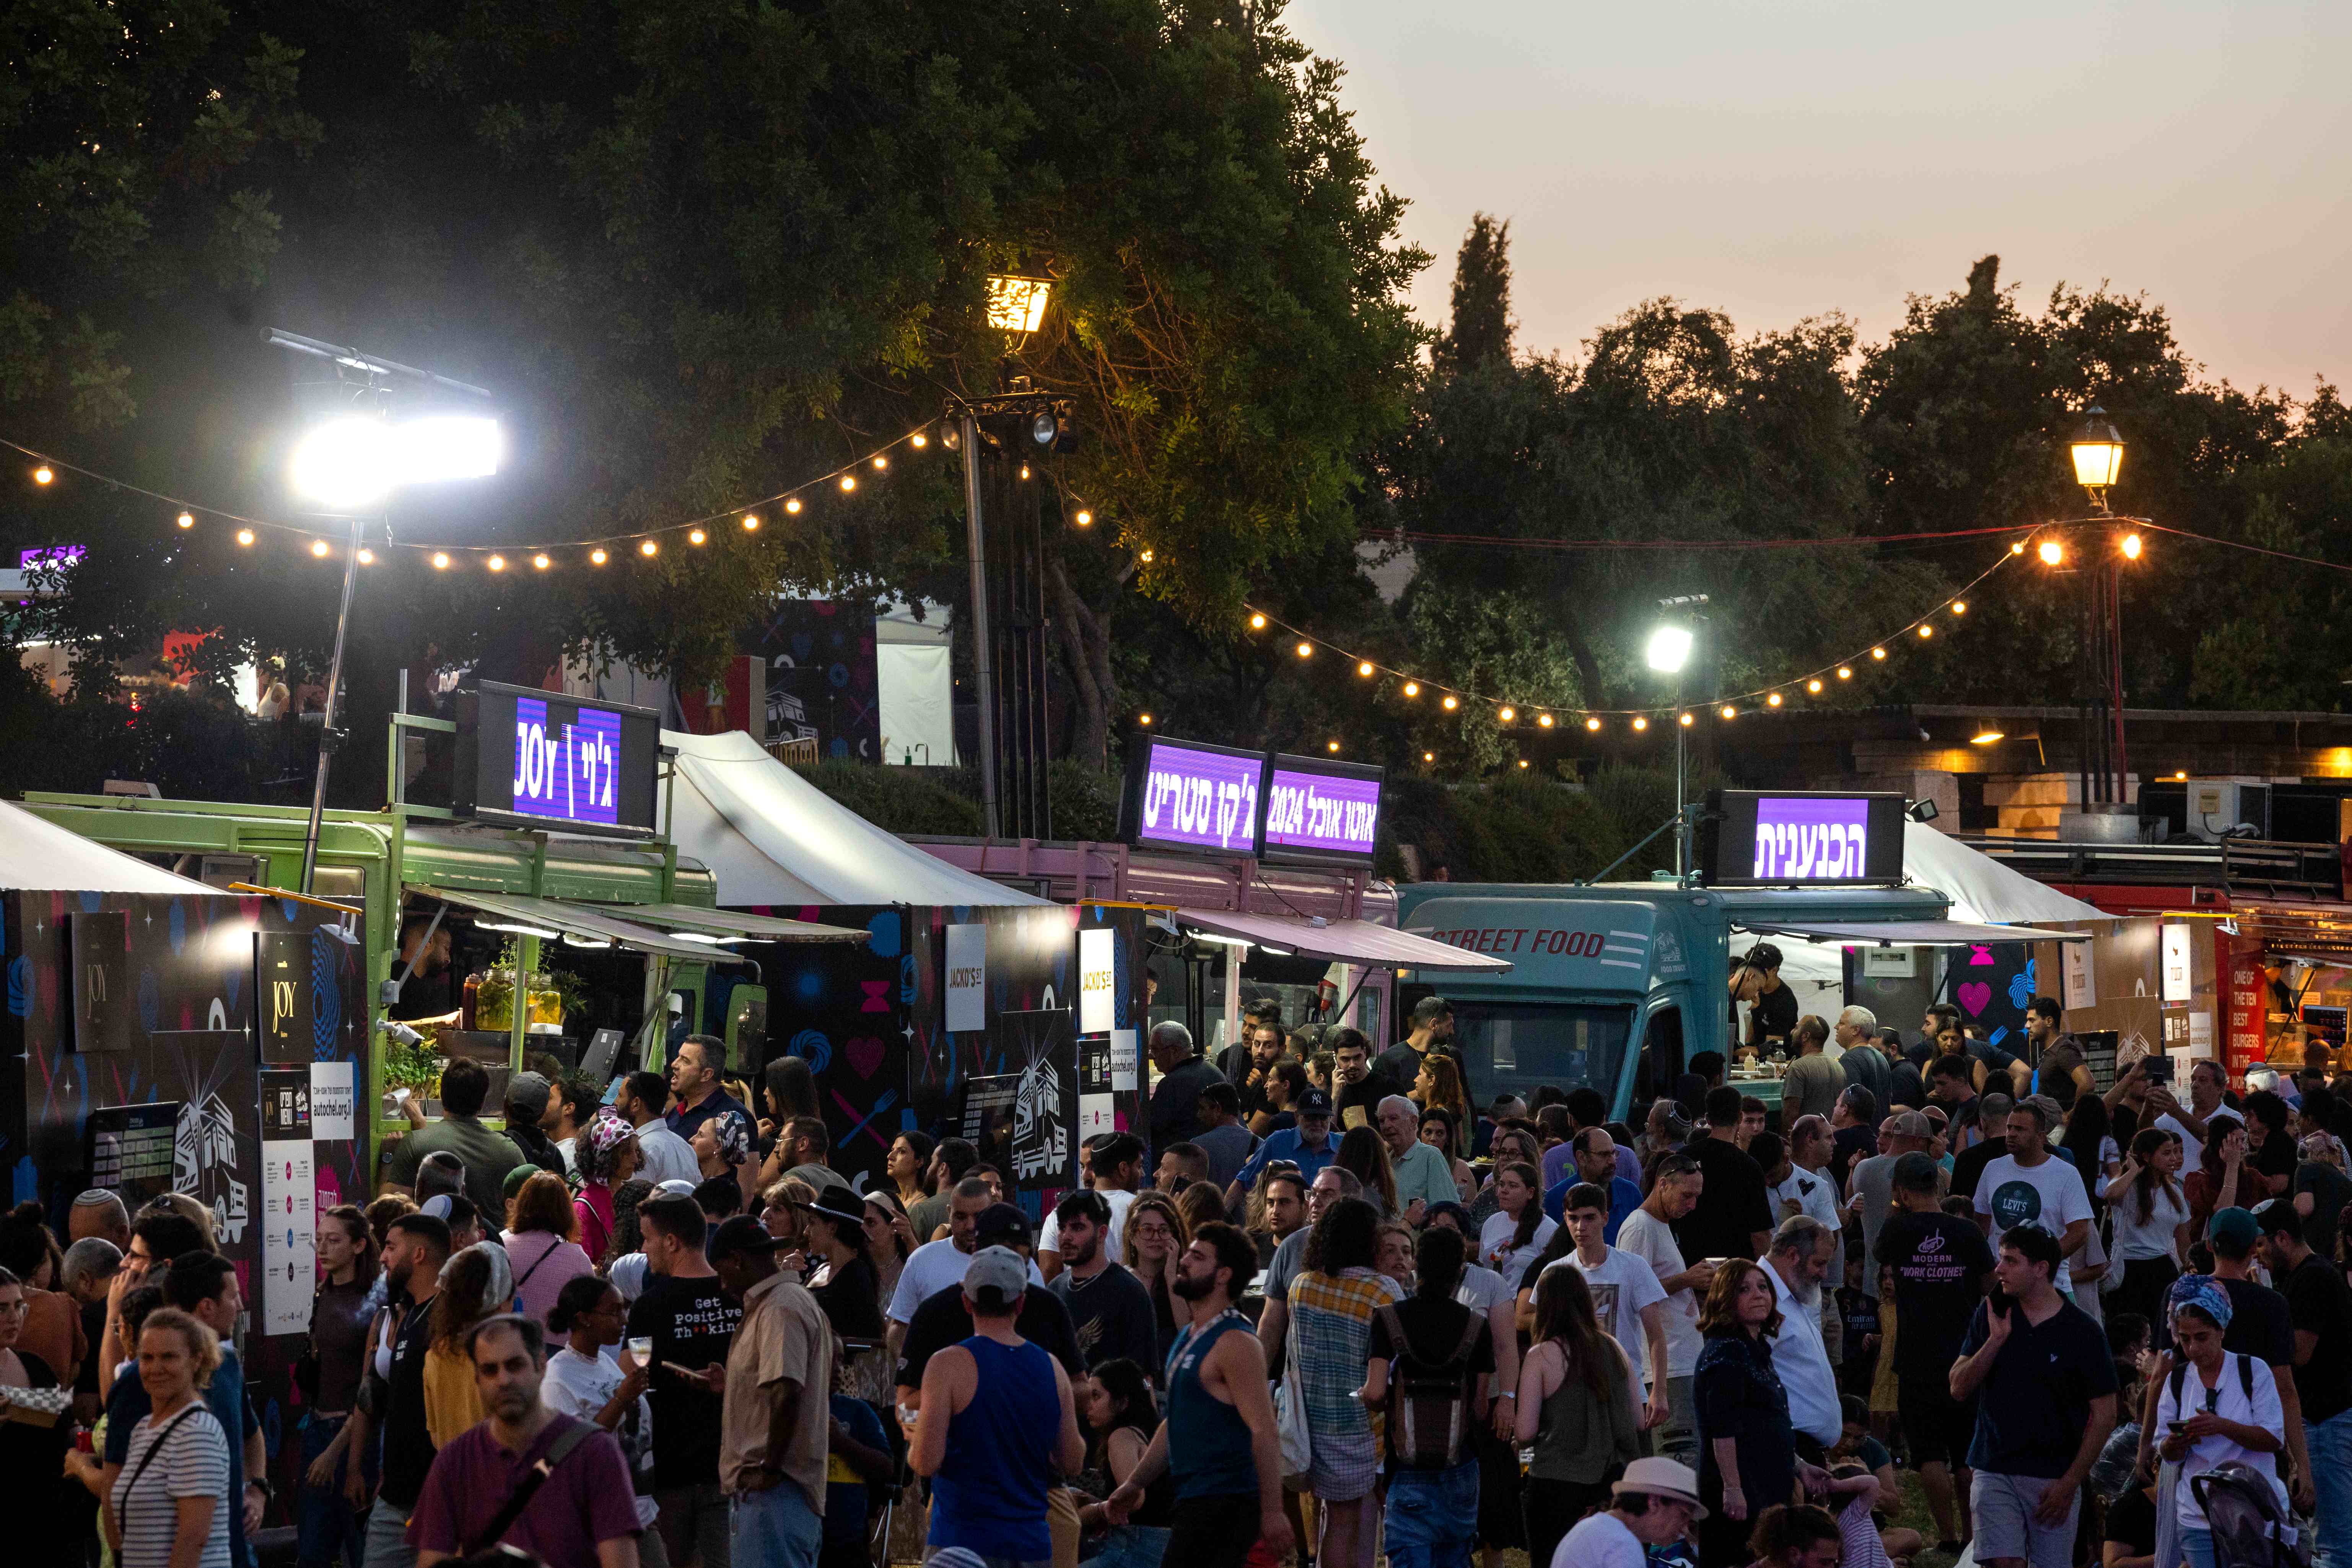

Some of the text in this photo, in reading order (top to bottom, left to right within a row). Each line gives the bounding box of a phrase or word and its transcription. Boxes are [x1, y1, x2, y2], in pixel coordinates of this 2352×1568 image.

[514, 722, 557, 799] JOY
[582, 731, 612, 807] ג'וי
[1145, 772, 1255, 848] ג'קו סטריט
[1267, 785, 1377, 842] אוטו אוכל 2024
[1754, 824, 1865, 878] הכנענית
[1531, 929, 1605, 958] FOOD
[949, 967, 982, 989] JACKO'S ST
[1083, 971, 1111, 992] JACKO'S ST
[2234, 971, 2254, 985] ONE OF
[88, 964, 109, 1019] JOY
[2234, 992, 2256, 1006] THE TEN
[273, 982, 296, 1033] JOY
[2233, 1013, 2248, 1027] BEST
[2233, 1034, 2259, 1048] BURGERS
[1112, 1058, 1136, 1075] autochel.org.il
[2232, 1055, 2251, 1068] IN THE
[1312, 1094, 1322, 1104] NY
[280, 1108, 292, 1125] MENU
[314, 1099, 352, 1120] autochel.org.il
[2002, 1198, 2027, 1212] LEVI'S
[1900, 1266, 1966, 1277] "WORK CLOTHES"
[695, 1297, 721, 1309] Get
[674, 1322, 735, 1338] Thkin
